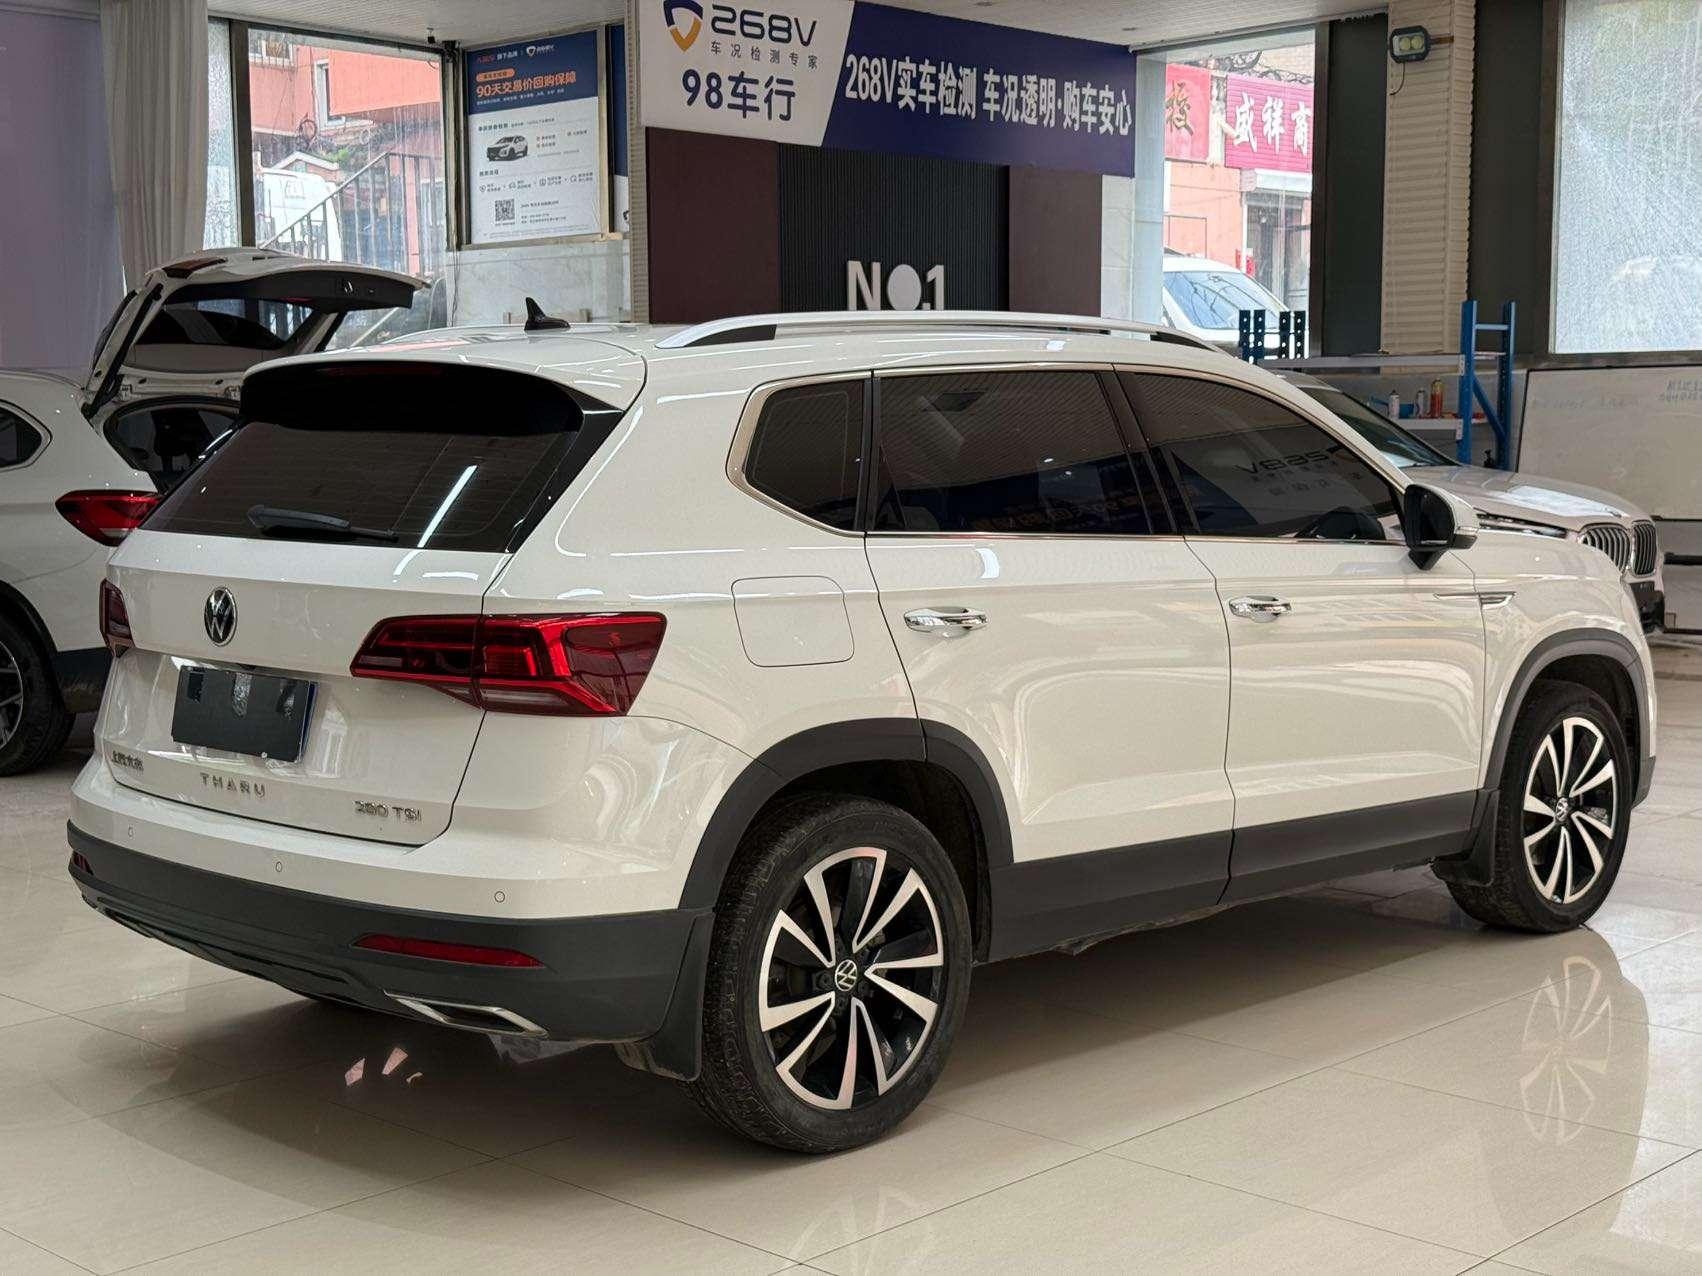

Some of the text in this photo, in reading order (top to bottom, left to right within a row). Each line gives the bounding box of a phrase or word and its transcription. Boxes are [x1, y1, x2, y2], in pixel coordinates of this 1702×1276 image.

[711, 4, 817, 47] 268V
[711, 40, 818, 69] 车况检测专家
[683, 69, 796, 121] 98车行
[845, 54, 977, 119] 268V实车检测
[982, 68, 1132, 136] 车况透明·购车安心
[200, 772, 266, 799] THARU
